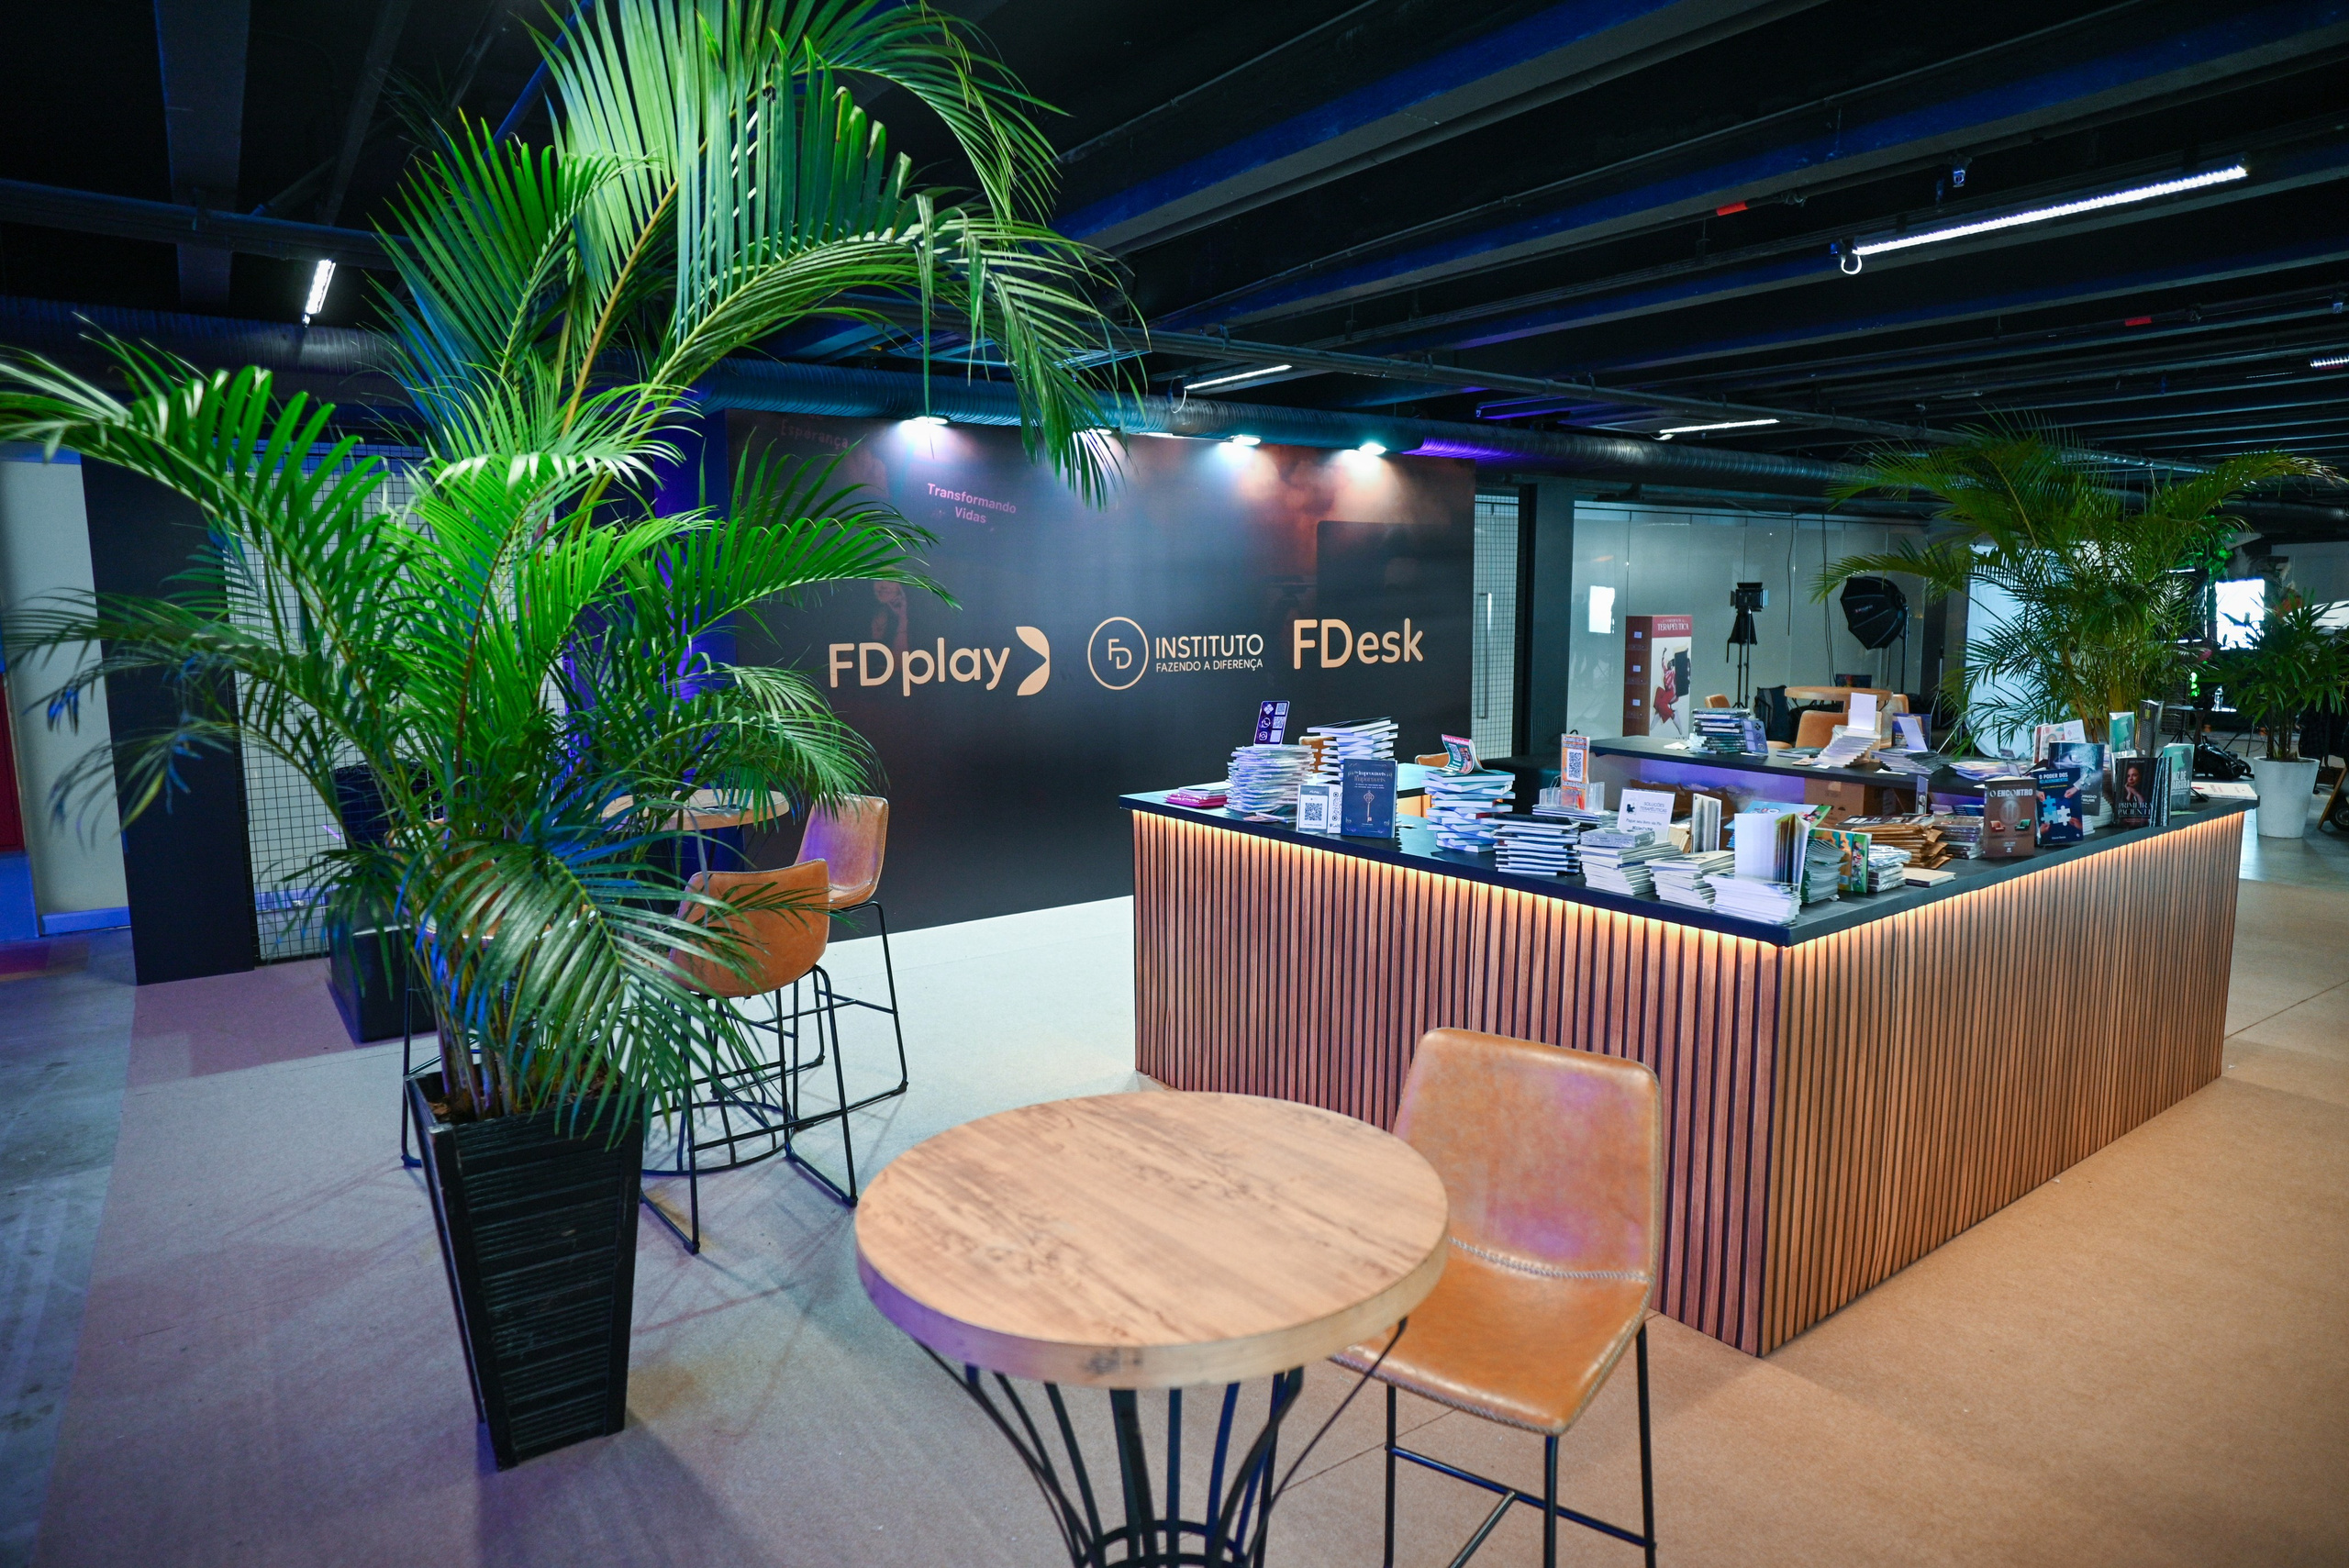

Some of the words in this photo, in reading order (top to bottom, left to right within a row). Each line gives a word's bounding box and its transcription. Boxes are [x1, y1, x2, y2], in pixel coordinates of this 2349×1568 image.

[927, 483, 1017, 514] Transformando
[954, 506, 987, 524] Vidas
[1156, 634, 1264, 660] INSTITUTO
[1294, 618, 1424, 670] FDesk
[1156, 661, 1202, 673] FAZENDO
[1204, 661, 1211, 671] A
[1213, 658, 1264, 672] DIFERENÇA
[1997, 789, 2033, 797] ENCONTRO
